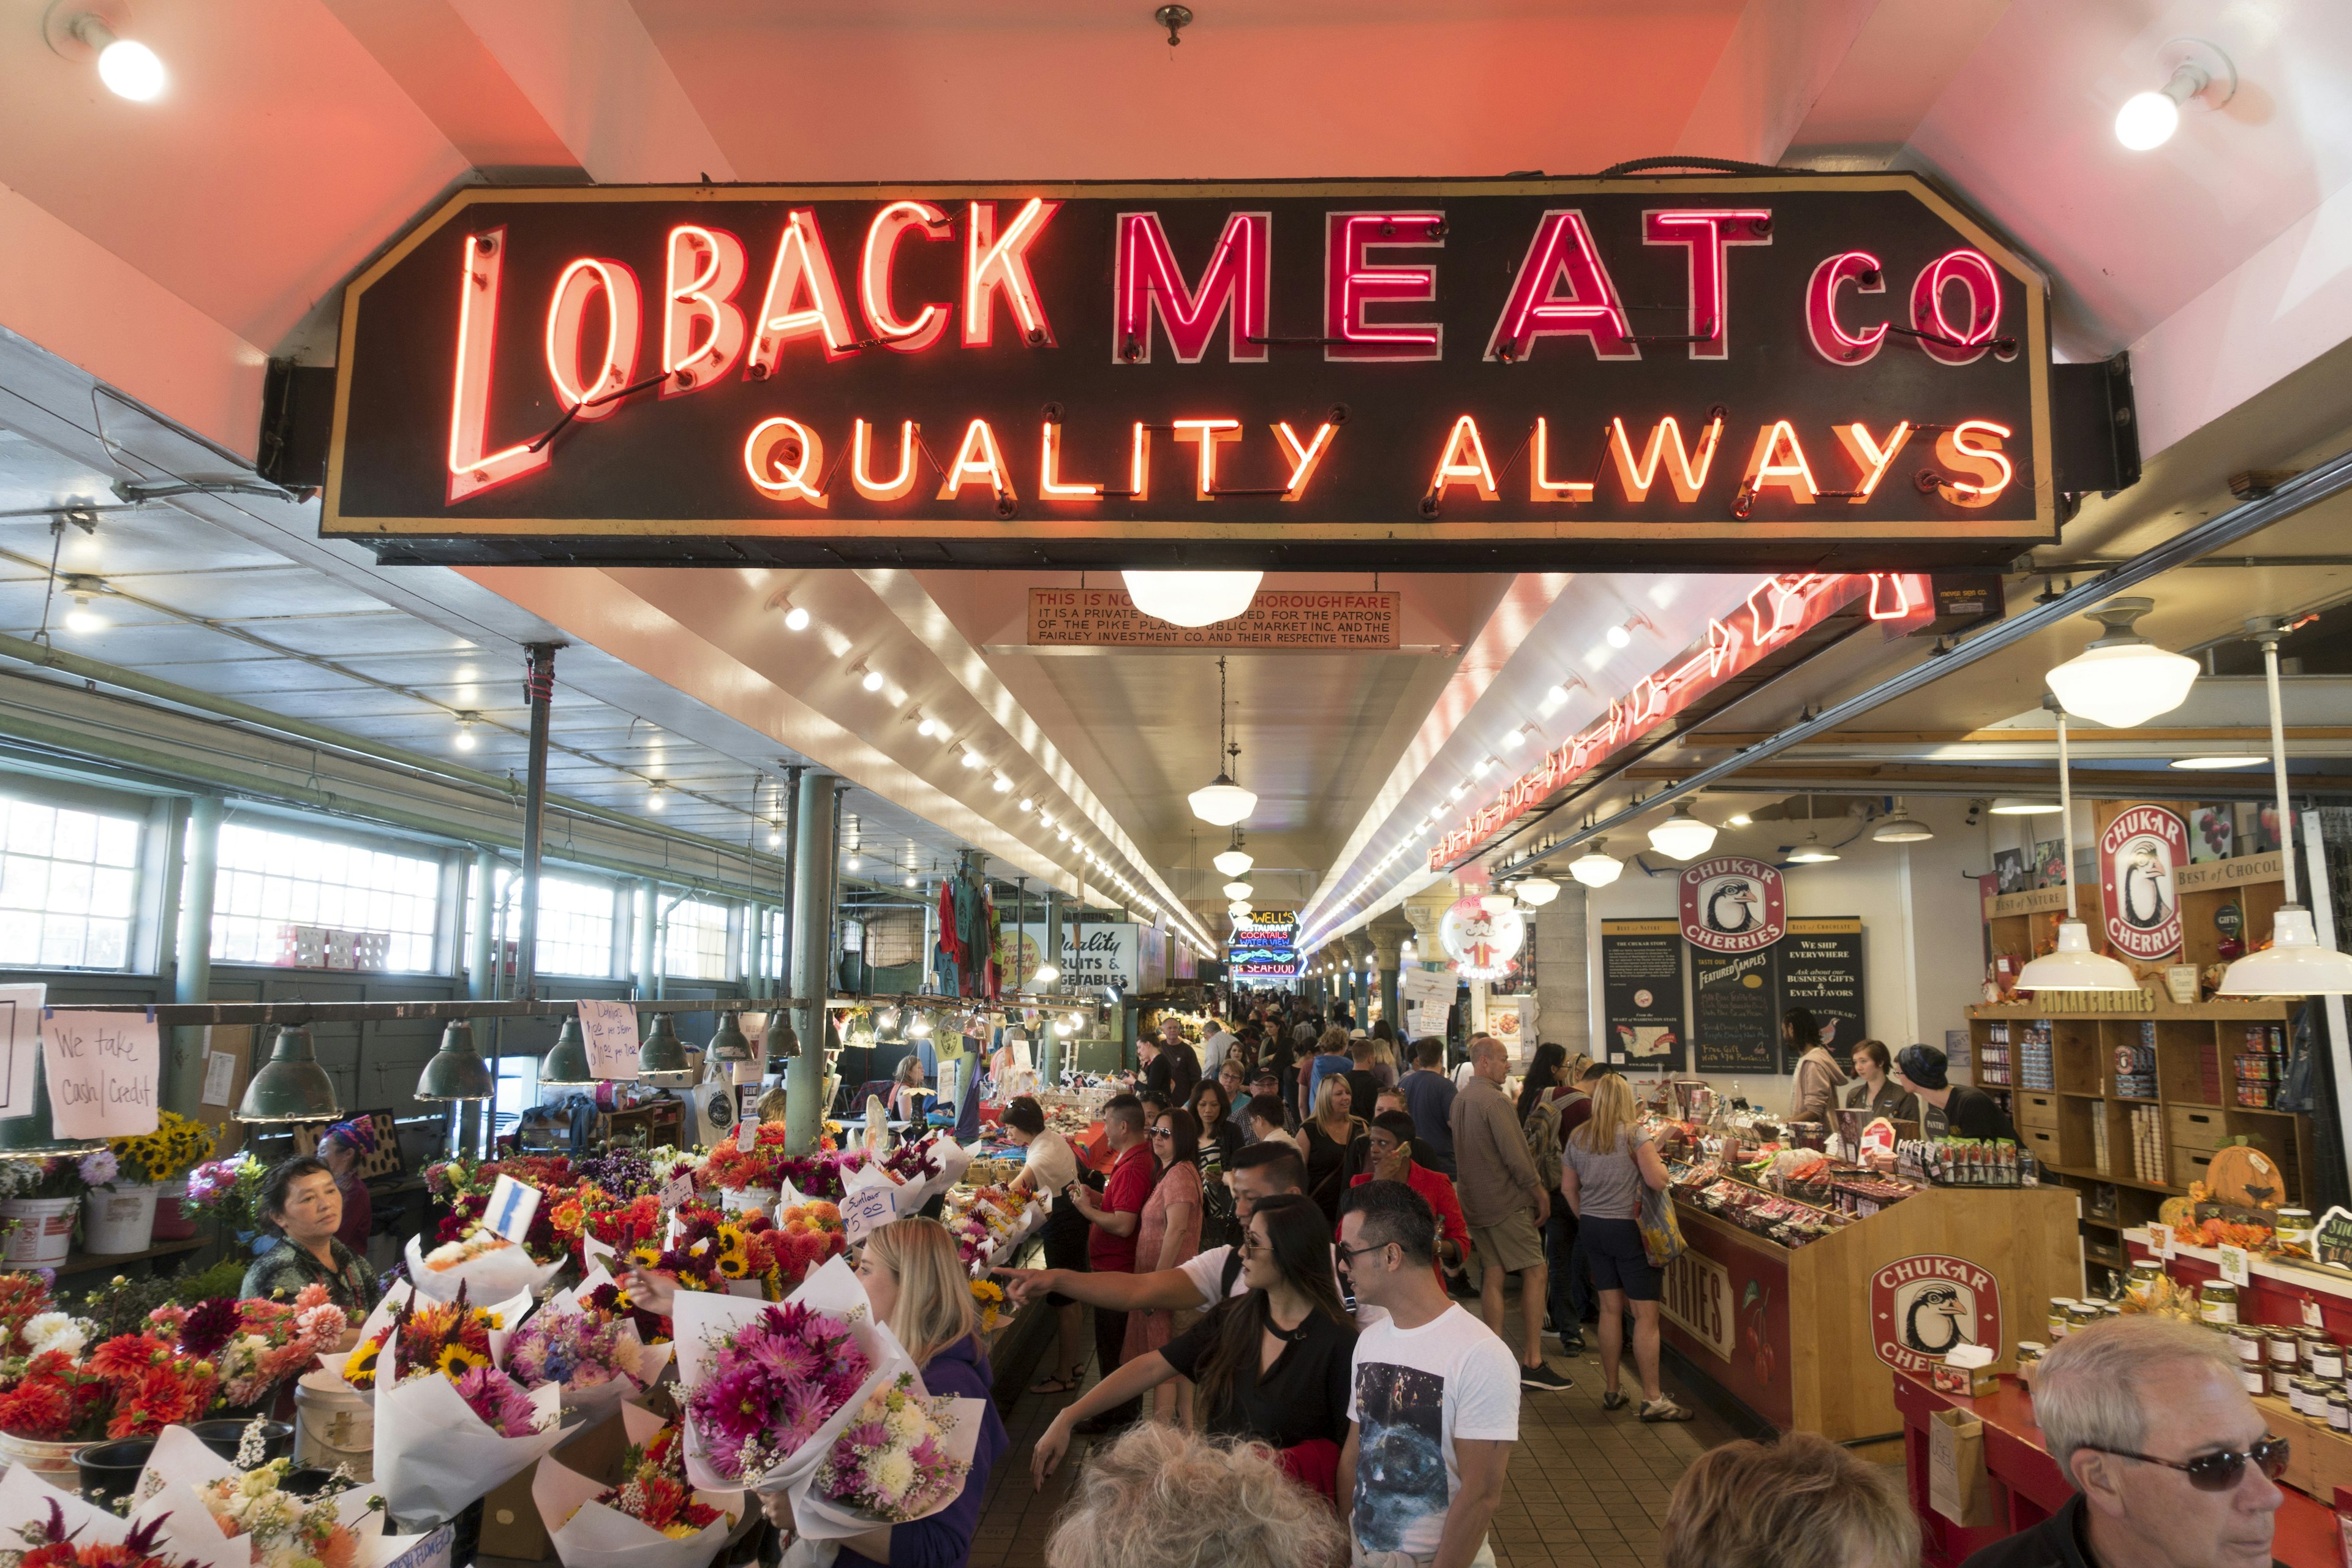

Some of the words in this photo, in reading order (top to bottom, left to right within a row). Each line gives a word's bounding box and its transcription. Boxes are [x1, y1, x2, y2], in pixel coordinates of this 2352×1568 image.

[445, 197, 1066, 506] LOBACK
[1112, 208, 1773, 363] MEAT
[744, 418, 1343, 509] QUALITY
[1434, 414, 2014, 508] ALWAYS
[1036, 593, 1076, 605] THIS
[1084, 594, 1102, 606] IS
[1108, 594, 1134, 606] NO
[1254, 595, 1390, 608] HOROUGHFARE
[1038, 620, 1057, 630] OF
[1064, 620, 1090, 630] THE
[1096, 620, 1131, 630] PIKE
[1196, 621, 1248, 631] UBLIC
[1253, 622, 1307, 631] MARKET
[1311, 622, 1334, 632] INC.
[1337, 622, 1363, 632] AND
[1365, 623, 1390, 632] THE
[1039, 609, 1050, 618] IT
[1055, 609, 1067, 618] IS
[1072, 609, 1079, 618] A
[1084, 609, 1138, 619] PRIVATE
[1272, 611, 1299, 620] FOR
[1303, 611, 1329, 620] THE
[1333, 611, 1392, 621] PATRONS
[1038, 631, 1093, 641] FAIRLEY
[1098, 631, 1179, 641] INVESTMENT
[1185, 632, 1205, 642] CO.
[1208, 633, 1232, 642] AND
[1237, 633, 1272, 642] THEIR
[1276, 633, 1337, 643] RESPECTIVE
[1341, 634, 1390, 643] TENANTS
[2104, 810, 2179, 854] CHUKAR
[1686, 859, 1776, 885] CHUKAR
[2178, 870, 2207, 886] BEST
[2211, 868, 2222, 883] of
[2225, 859, 2284, 878] CHOCOL
[1995, 897, 2014, 911] BEST
[2026, 892, 2060, 907] NATURE
[1060, 931, 1122, 957] uality
[1686, 923, 1781, 949] CHERRIES
[1060, 957, 1103, 970] RUITS
[1109, 957, 1120, 970] &
[1247, 964, 1295, 974] SEAFOOD
[1455, 962, 1510, 981] PRODUCE
[1699, 965, 1735, 990] FEATURED
[1732, 952, 1766, 981] SAMPLES
[2090, 987, 2156, 1012] CHERRIES
[1823, 1009, 1857, 1019] CHUKAR?
[55, 1027, 85, 1058] We
[94, 1027, 139, 1062] take
[1927, 1120, 1945, 1131] PANTRY
[1879, 1259, 1989, 1292] CHUKAR
